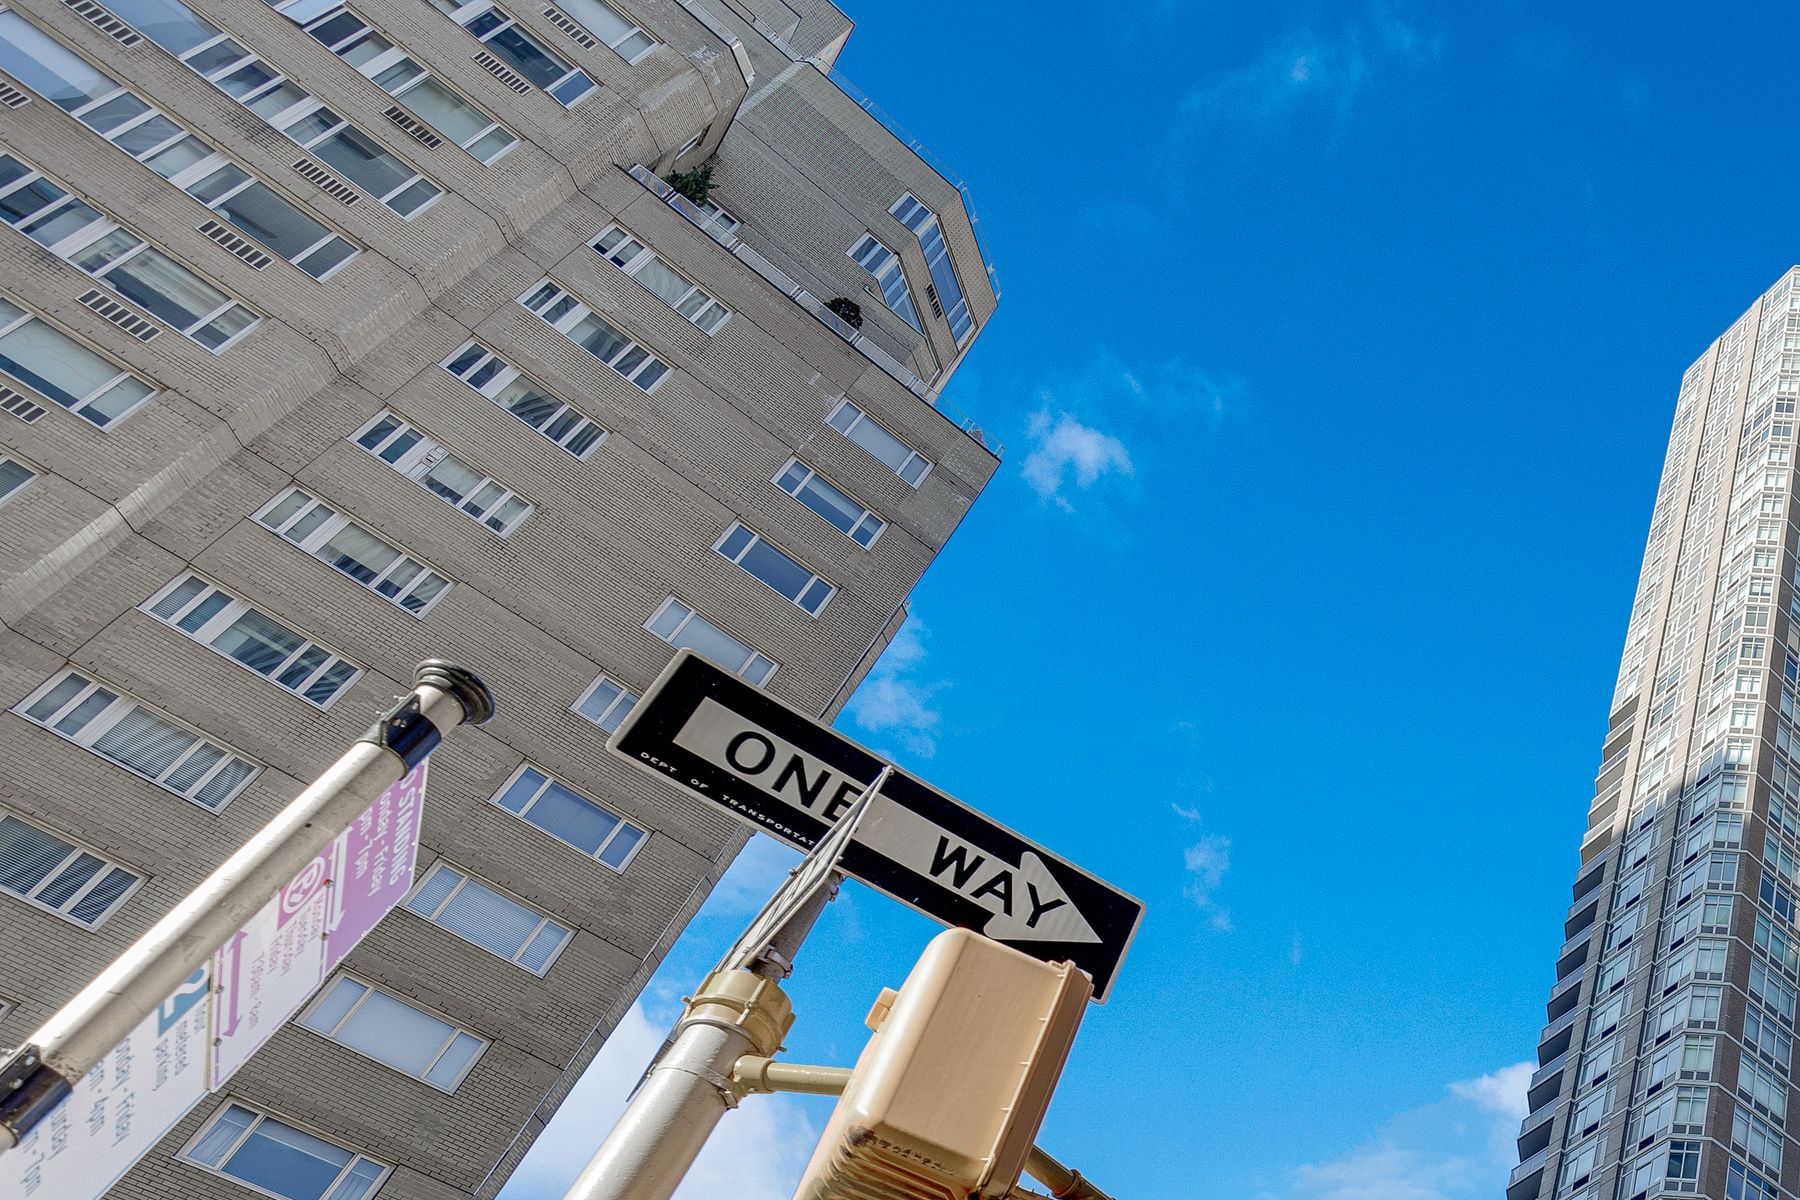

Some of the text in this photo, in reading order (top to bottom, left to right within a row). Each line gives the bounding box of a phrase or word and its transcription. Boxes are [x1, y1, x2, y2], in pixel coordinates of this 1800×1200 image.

[358, 807, 374, 836] pm
[374, 791, 393, 841] onday
[640, 751, 816, 846] DEPT OF TRANSPORTAT
[389, 786, 416, 886] STANDING
[725, 730, 1068, 929] ONE WAY
[367, 845, 388, 897] Friday
[88, 1061, 105, 1091] am
[111, 1038, 135, 1091] onday
[111, 1091, 135, 1148] Friday
